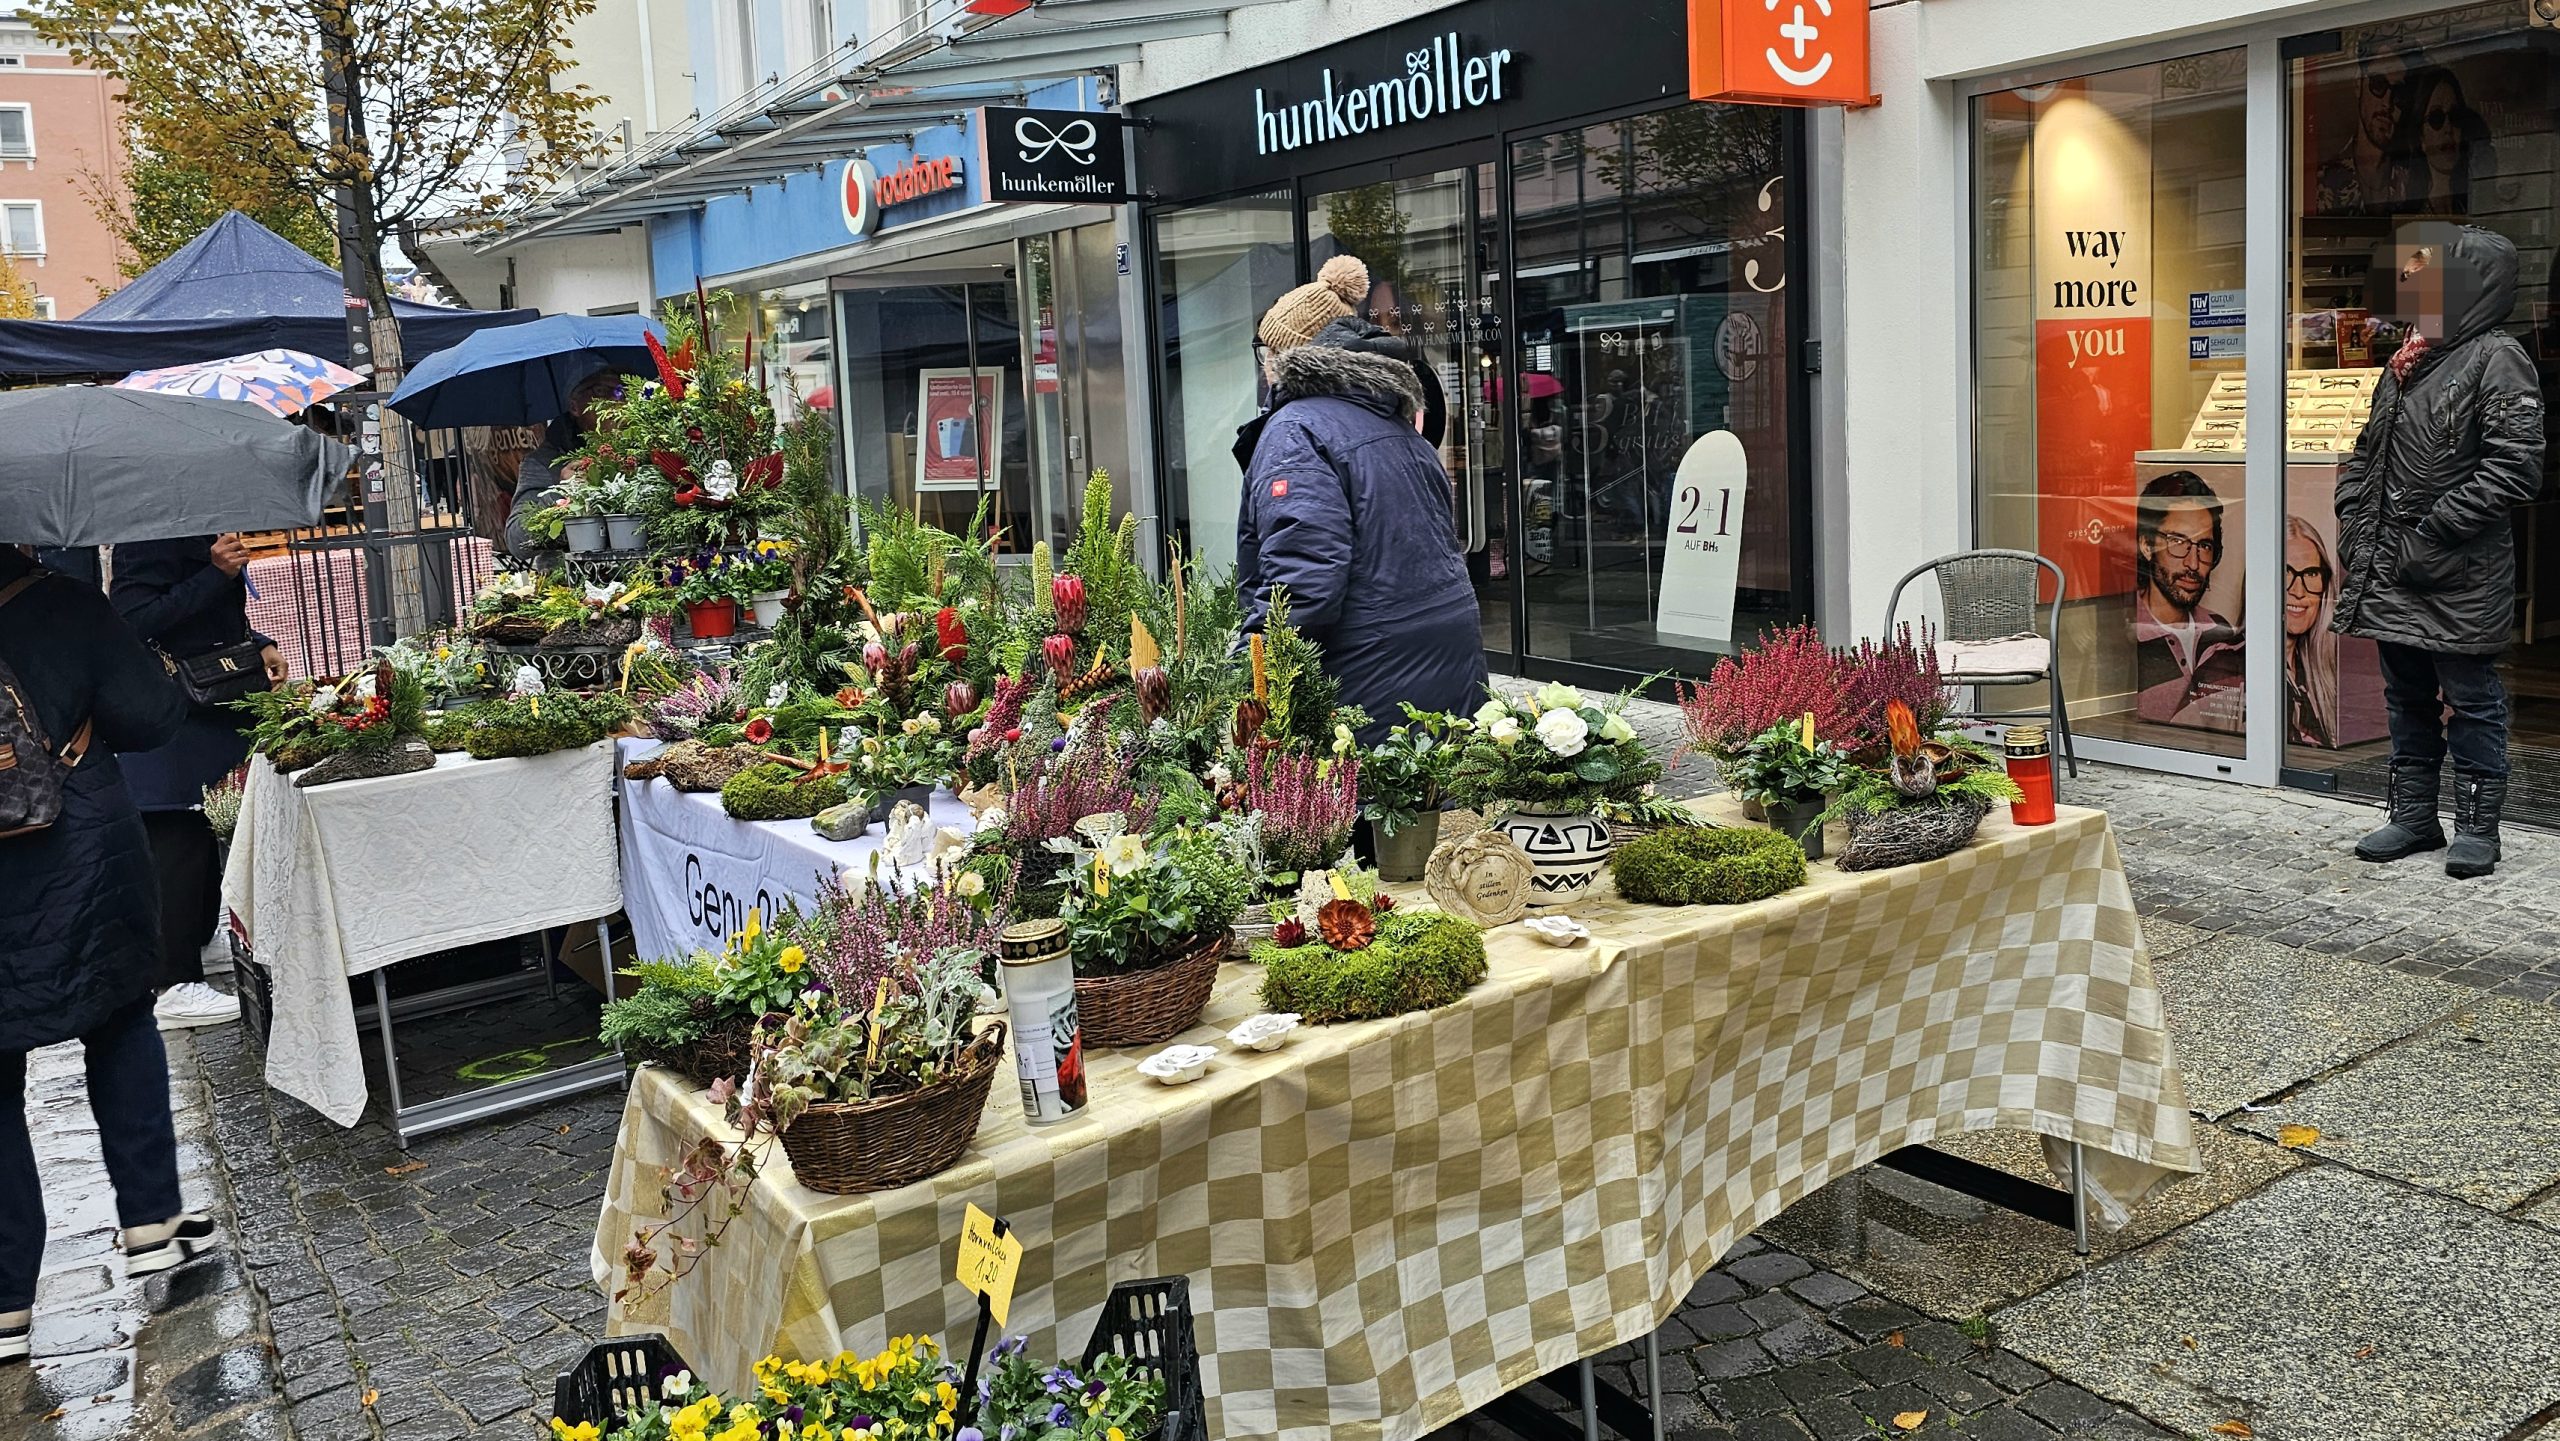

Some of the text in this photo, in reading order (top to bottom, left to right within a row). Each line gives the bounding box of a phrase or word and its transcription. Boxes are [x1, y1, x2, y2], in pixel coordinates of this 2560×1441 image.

[1256, 31, 1511, 155] hunkemöller
[872, 153, 953, 207] vodafone
[1001, 171, 1115, 194] hunkemöller
[2065, 230, 2126, 269] way
[2053, 280, 2137, 308] more
[2191, 295, 2208, 309] TÜV
[2066, 328, 2126, 369] you
[2191, 338, 2208, 352] TÜV
[2068, 524, 2126, 540] eyes more
[1685, 540, 1719, 553] AUF BHs
[1476, 889, 1508, 901] Gedenken
[1480, 880, 1501, 889] stillem
[974, 1255, 999, 1284] 1,20
